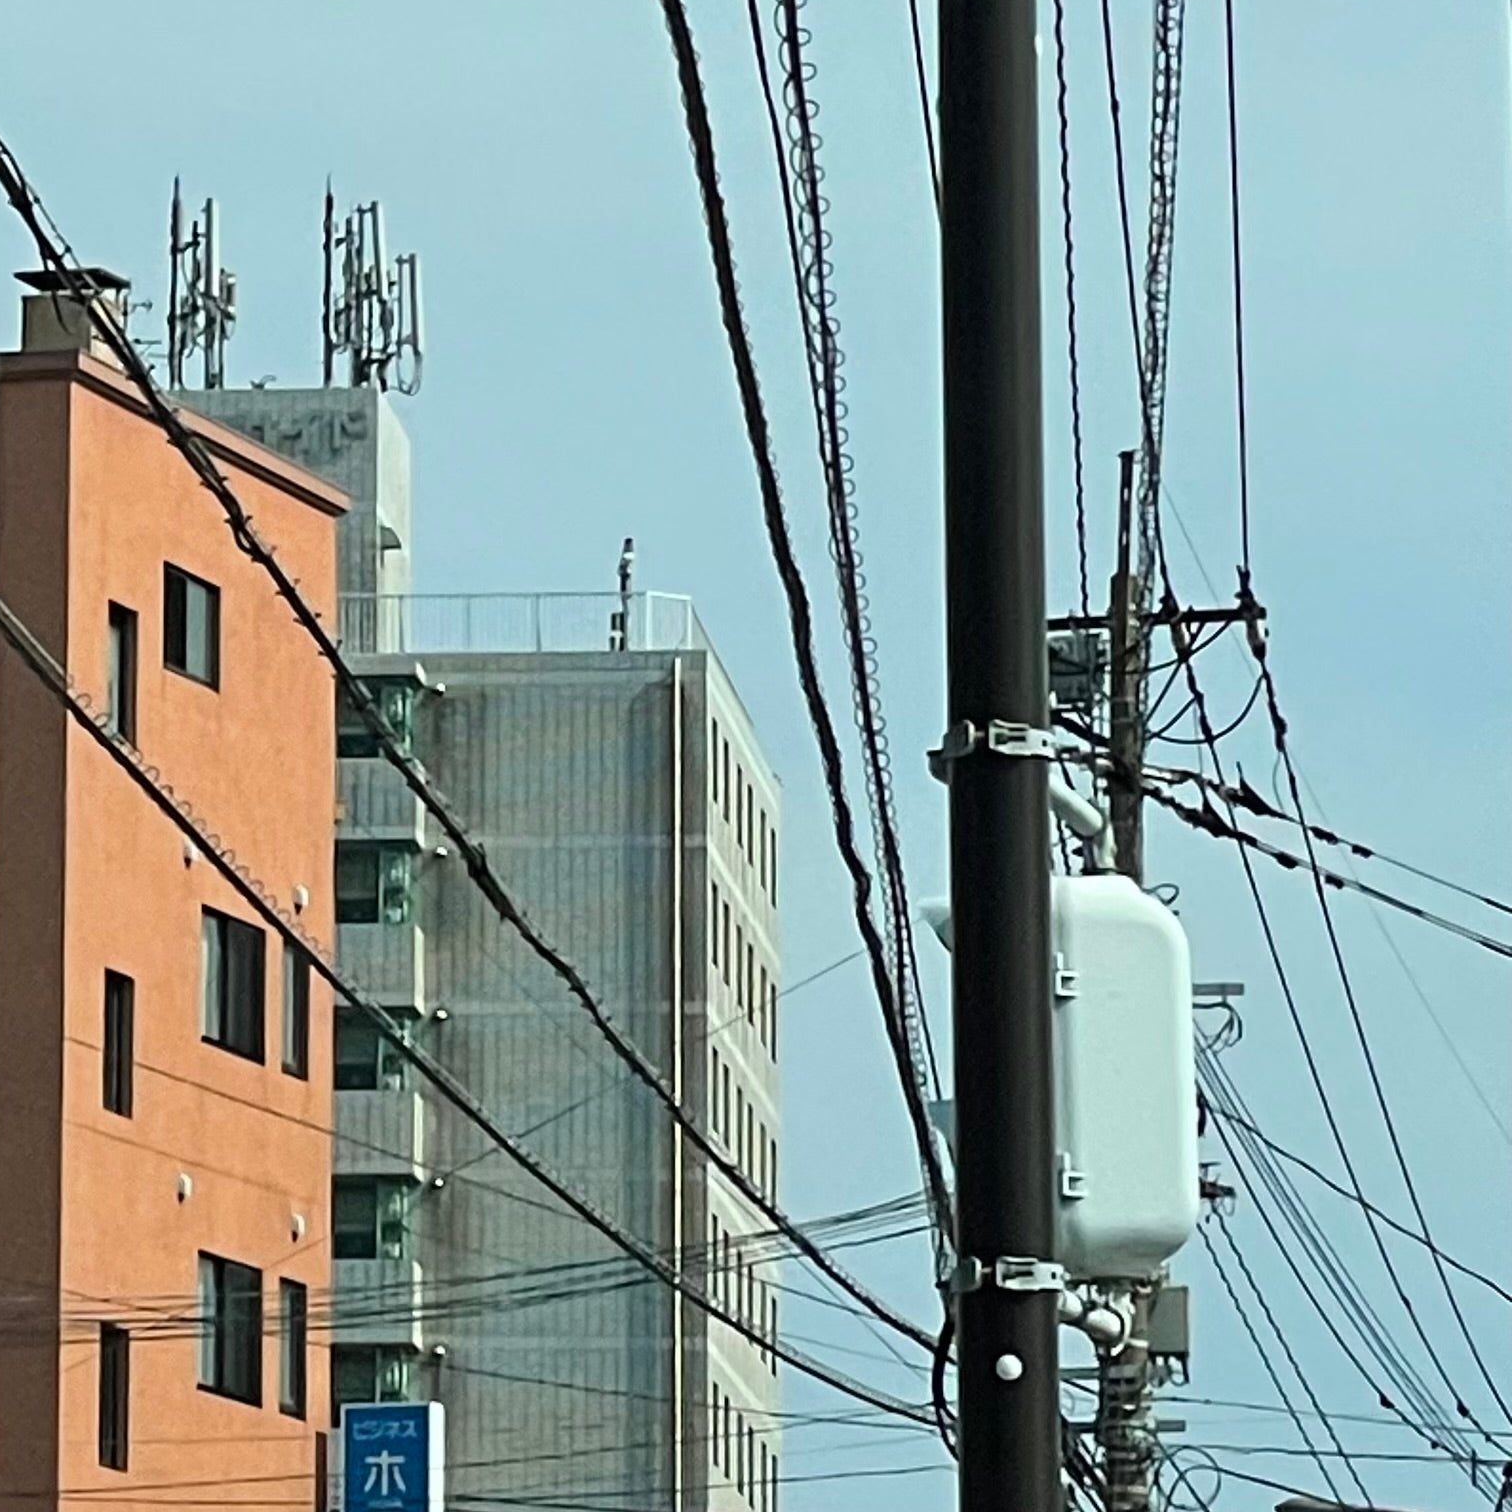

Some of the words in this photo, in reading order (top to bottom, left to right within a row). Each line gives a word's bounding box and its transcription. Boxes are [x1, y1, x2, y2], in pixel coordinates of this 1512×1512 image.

[352, 1419, 417, 1440] ビジネス
[363, 1449, 406, 1508] ホ
